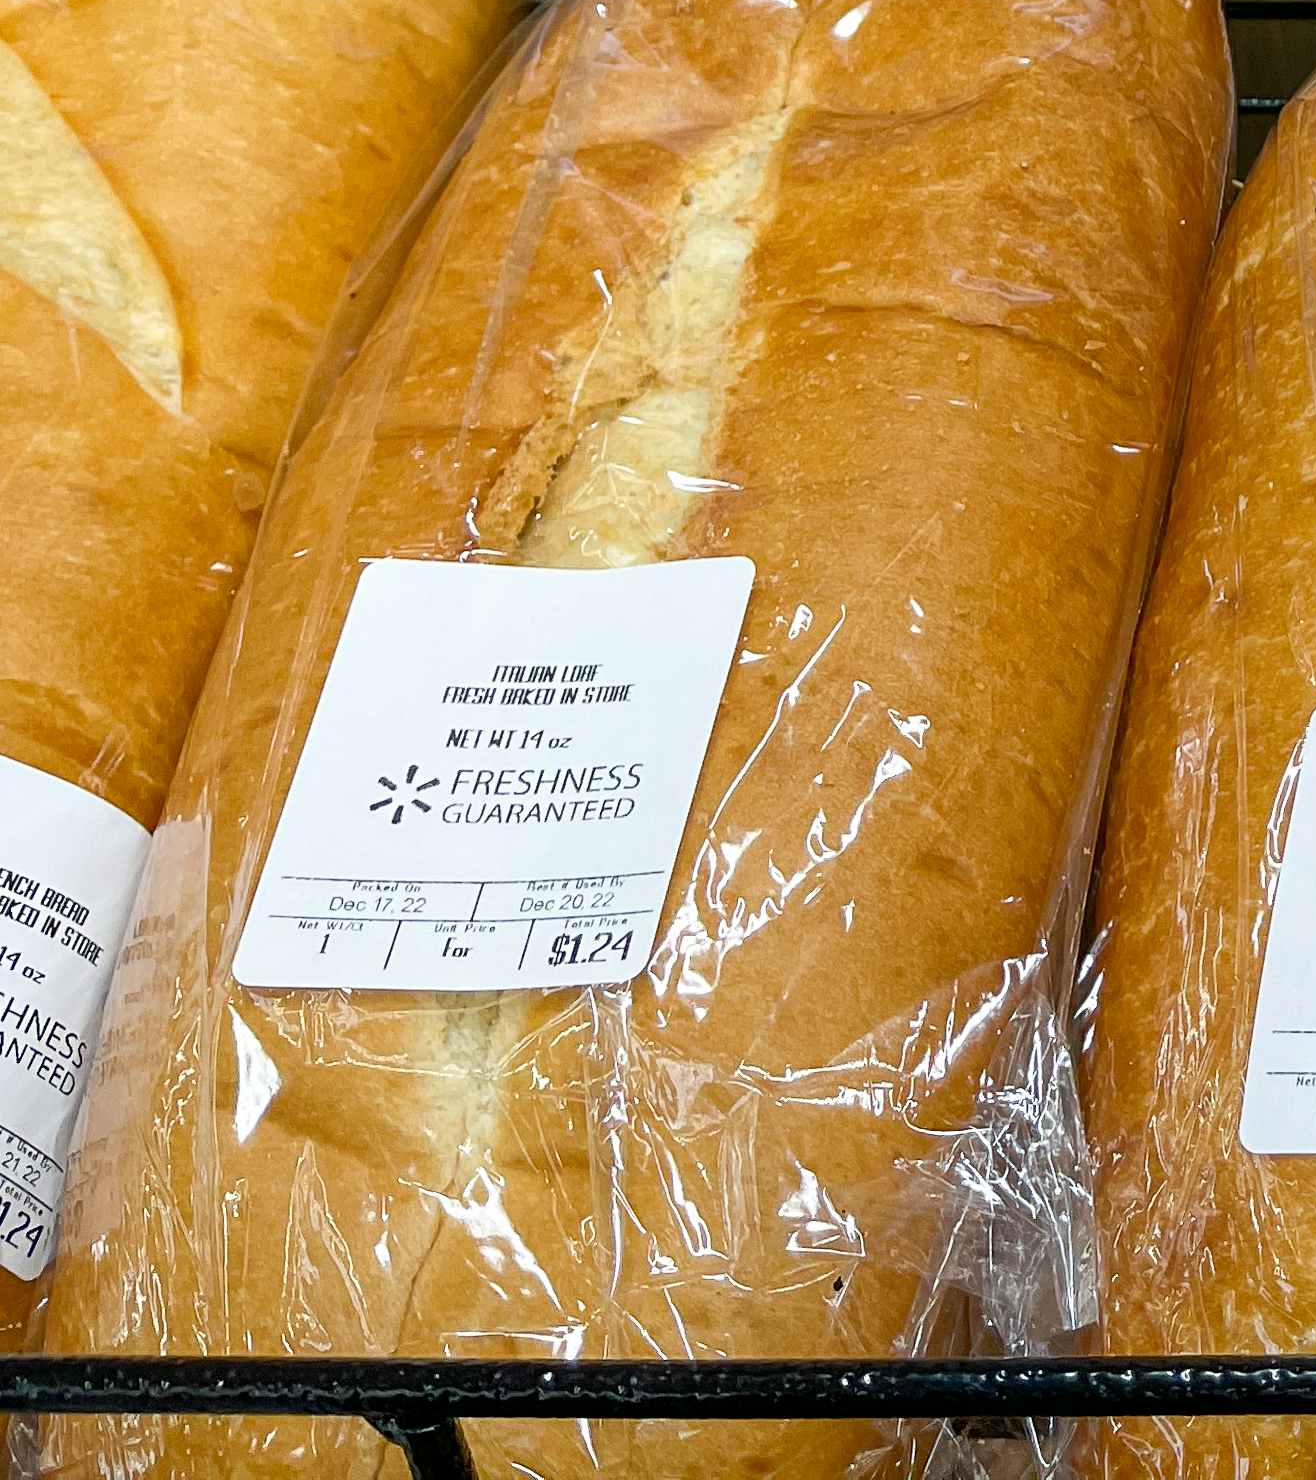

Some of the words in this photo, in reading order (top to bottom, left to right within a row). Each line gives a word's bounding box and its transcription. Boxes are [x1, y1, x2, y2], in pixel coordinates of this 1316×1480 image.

[492, 664, 557, 683] ITALIAN
[561, 663, 603, 682] LOAF
[441, 686, 497, 704] FRESH
[500, 687, 554, 706] BAKED
[559, 686, 580, 705] IN
[582, 684, 636, 704] STORE
[446, 728, 484, 749] NET
[488, 729, 518, 749] WT
[519, 729, 545, 749] 14
[548, 735, 573, 749] oz
[450, 763, 645, 796] FRESHNESS
[441, 797, 636, 824] GUARANTEED
[0, 867, 41, 901] ENCH
[40, 887, 91, 927] BREAD
[352, 881, 399, 893] Packed
[404, 884, 422, 893] On
[329, 896, 367, 912] Dec
[401, 897, 427, 913] 22
[519, 897, 555, 913] Dec
[591, 892, 616, 909] 22
[0, 894, 41, 929] AKED
[41, 914, 62, 939] IN
[61, 926, 105, 968] STORE
[298, 920, 319, 931] Net
[318, 932, 331, 955] 1
[441, 936, 474, 958] For
[547, 929, 635, 968] $1.24
[0, 945, 22, 971] 14
[22, 966, 47, 985] oz
[0, 994, 88, 1069] HNESS
[0, 1033, 76, 1097] NTEED
[1296, 1075, 1316, 1088] Net
[22, 1165, 41, 1188] 22
[0, 1197, 44, 1258] 1.24
